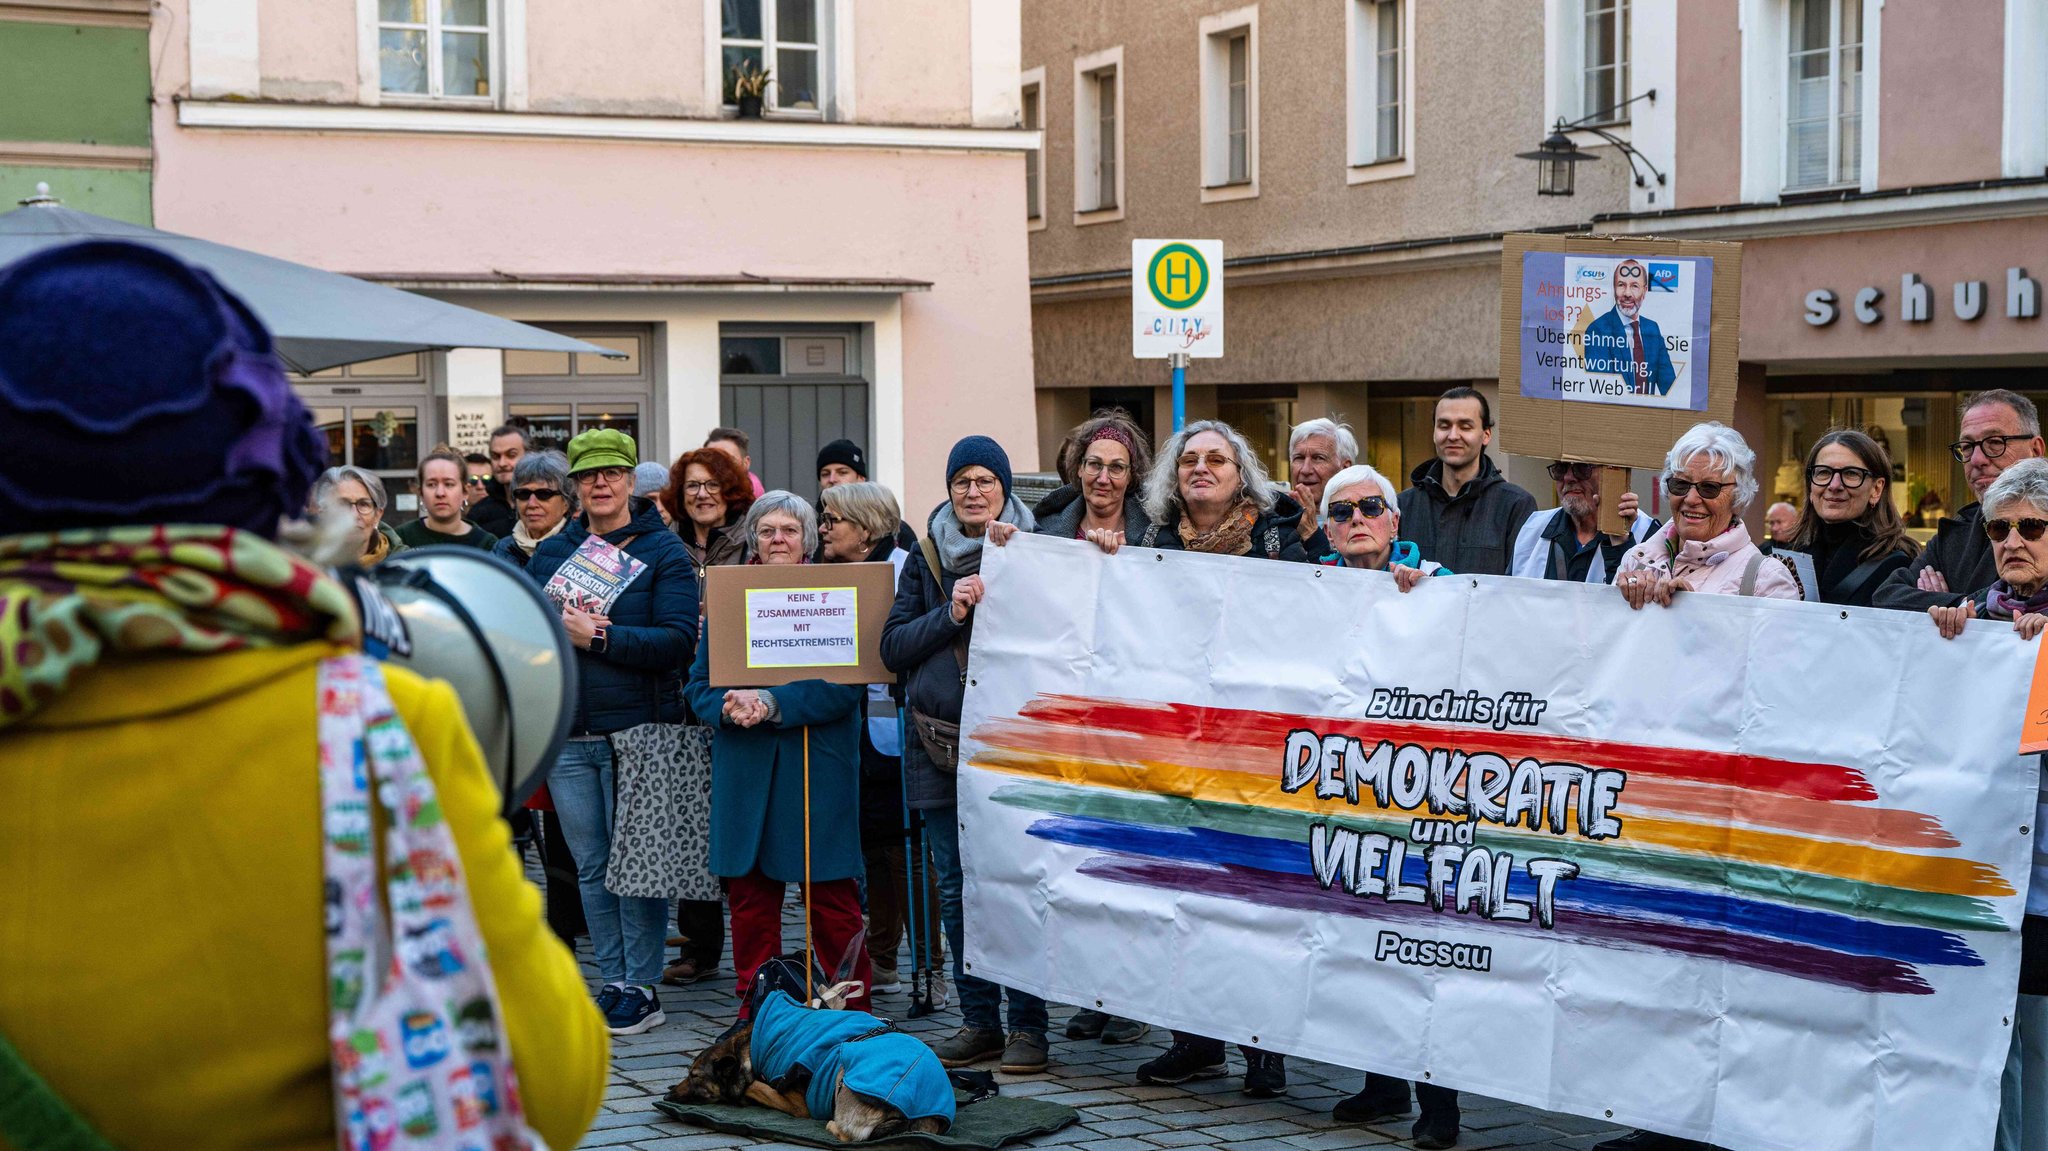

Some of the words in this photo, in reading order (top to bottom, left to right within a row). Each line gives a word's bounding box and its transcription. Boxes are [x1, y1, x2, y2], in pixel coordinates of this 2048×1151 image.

[1166, 258, 1191, 295] H
[1654, 268, 1672, 278] AfD
[1537, 281, 1607, 303] Ahnungs-
[1803, 266, 2042, 327] schuh
[1153, 318, 1202, 333] CITY
[1544, 306, 1582, 322] los??
[1536, 326, 1635, 349] Übernehmen
[1665, 335, 1689, 352] Sie
[1535, 351, 1653, 376] Verantwortung,
[1552, 376, 1585, 392] Herr
[591, 553, 619, 573] KEINE
[561, 563, 612, 597] FASCHISTEN!
[787, 593, 815, 602] KEINE
[757, 608, 846, 618] ZUSAMMENARBEIT
[793, 624, 810, 632] MIT
[751, 637, 853, 648] RECHTSEXTREMISTEN
[1365, 687, 1493, 723] Bündnis
[1492, 692, 1548, 730] für
[1281, 728, 1627, 840] DEMOKRATIE
[1409, 817, 1476, 845] und
[1309, 823, 1580, 930] VIELFALT
[1374, 930, 1492, 972] Passau
